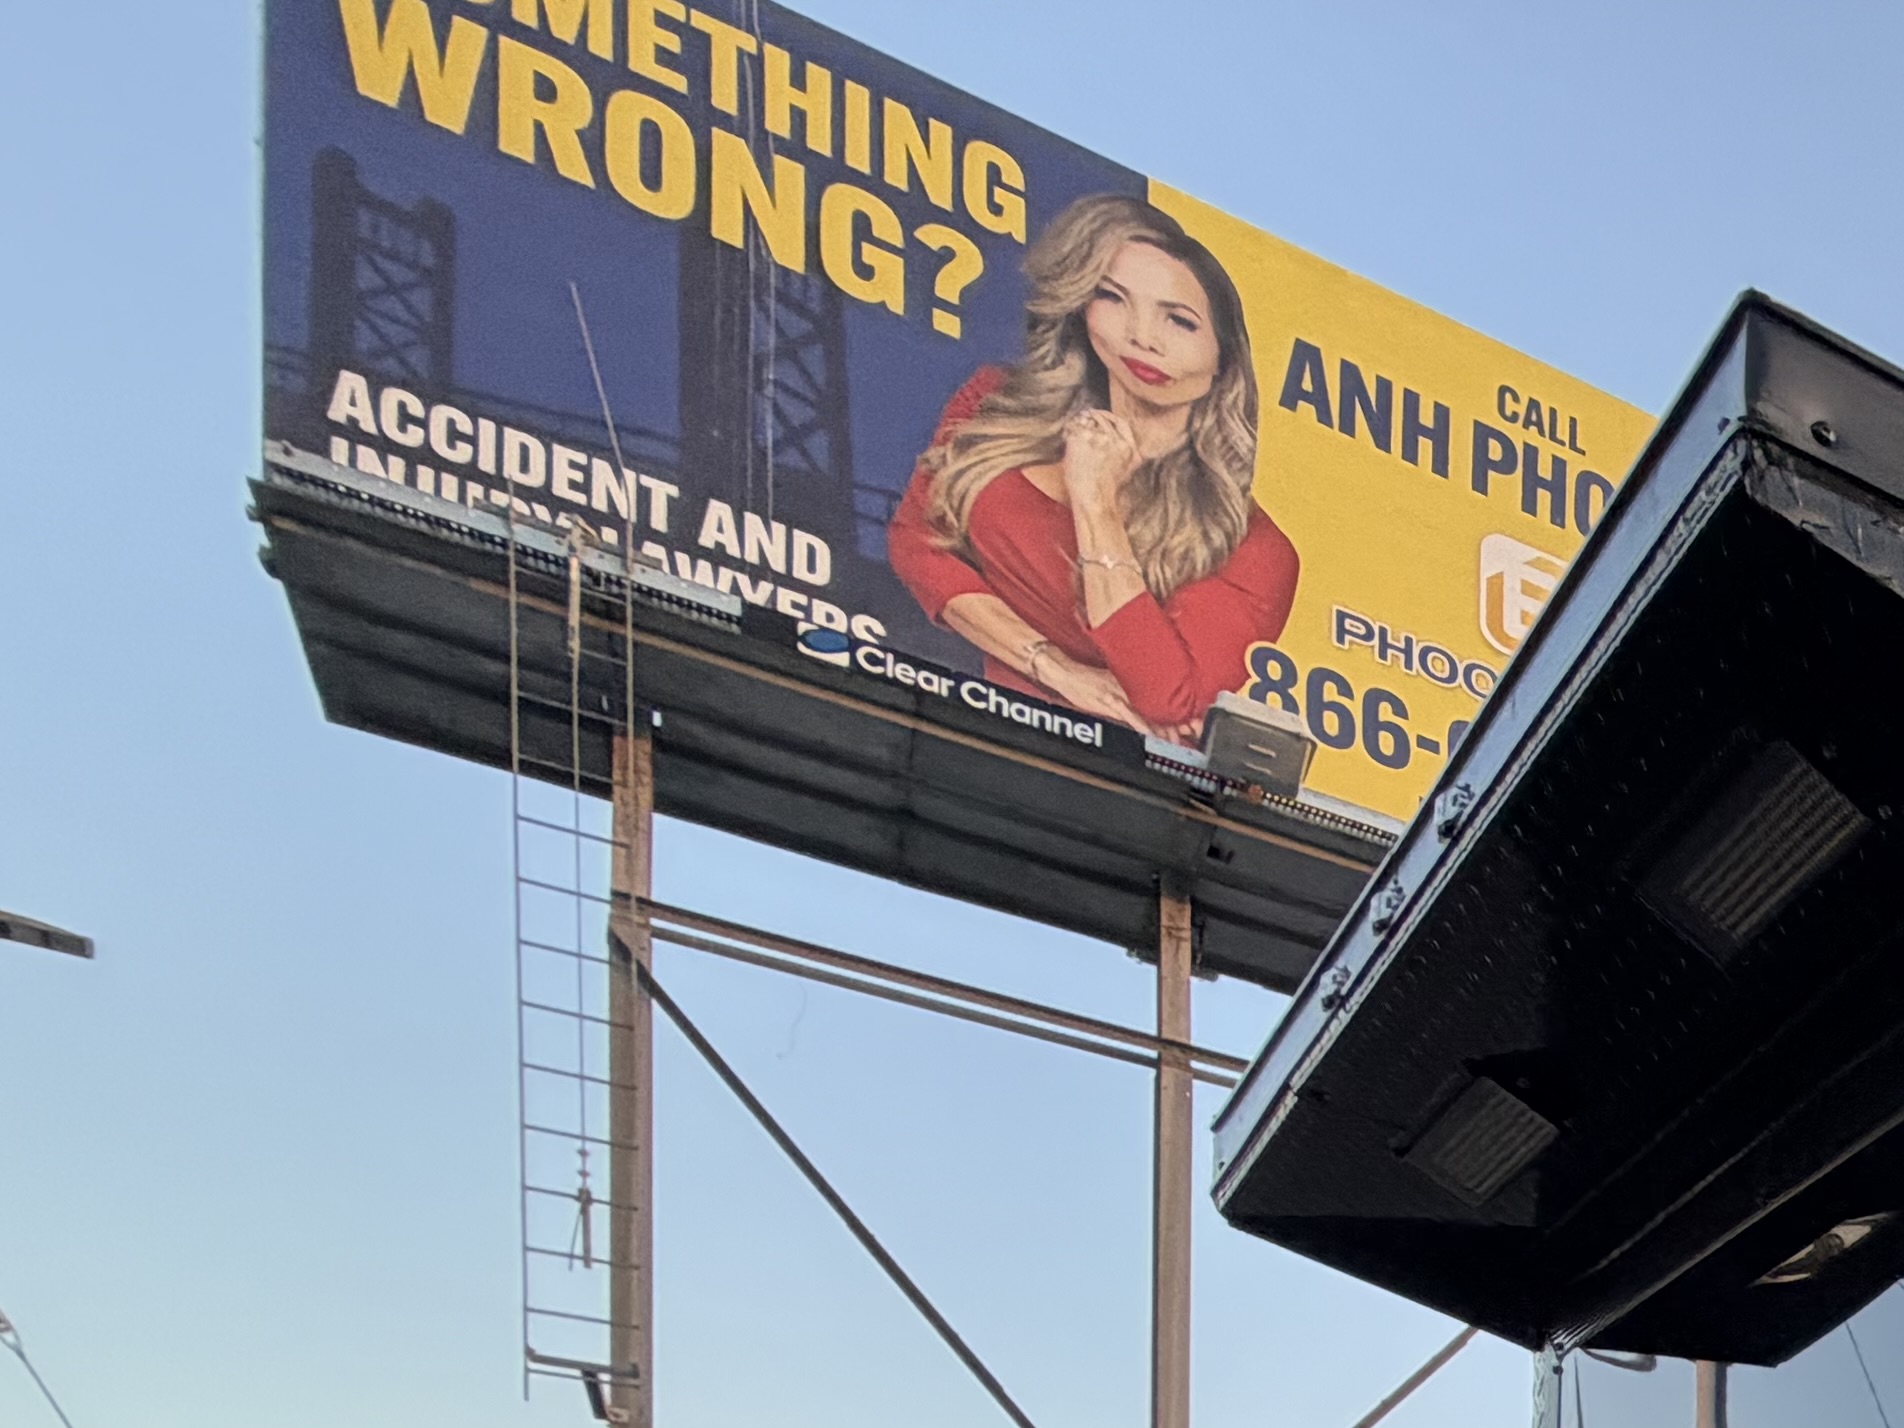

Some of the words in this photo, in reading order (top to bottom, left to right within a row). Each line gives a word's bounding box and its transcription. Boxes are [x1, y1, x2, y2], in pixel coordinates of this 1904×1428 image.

[339, 0, 984, 340] WRONG?
[463, 0, 1026, 245] METHING
[326, 370, 679, 531] ACCIDENT
[698, 498, 831, 587] AND
[1279, 337, 1450, 480] ANH
[1497, 384, 1586, 457] CALL
[856, 645, 955, 698] Clear
[960, 681, 1103, 748] Channel
